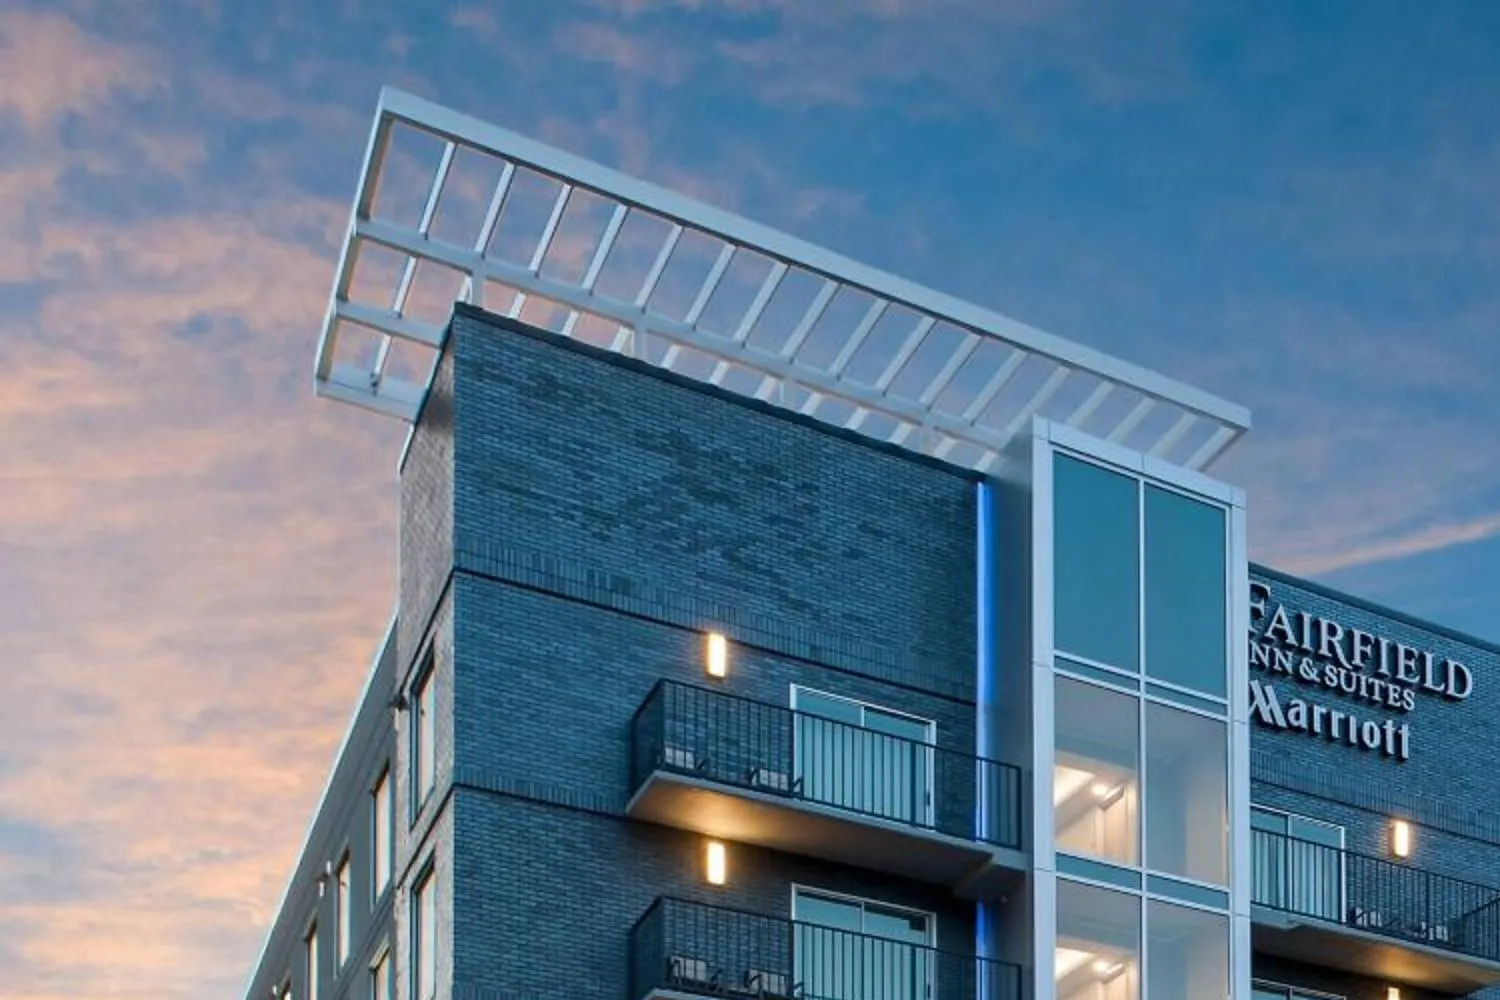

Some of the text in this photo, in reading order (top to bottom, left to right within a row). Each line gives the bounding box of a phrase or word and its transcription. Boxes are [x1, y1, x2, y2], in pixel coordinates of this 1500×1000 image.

[1249, 580, 1473, 699] FAIRFIELD
[1249, 640, 1415, 712] NN & SUITES
[1249, 679, 1409, 760] Marriott
